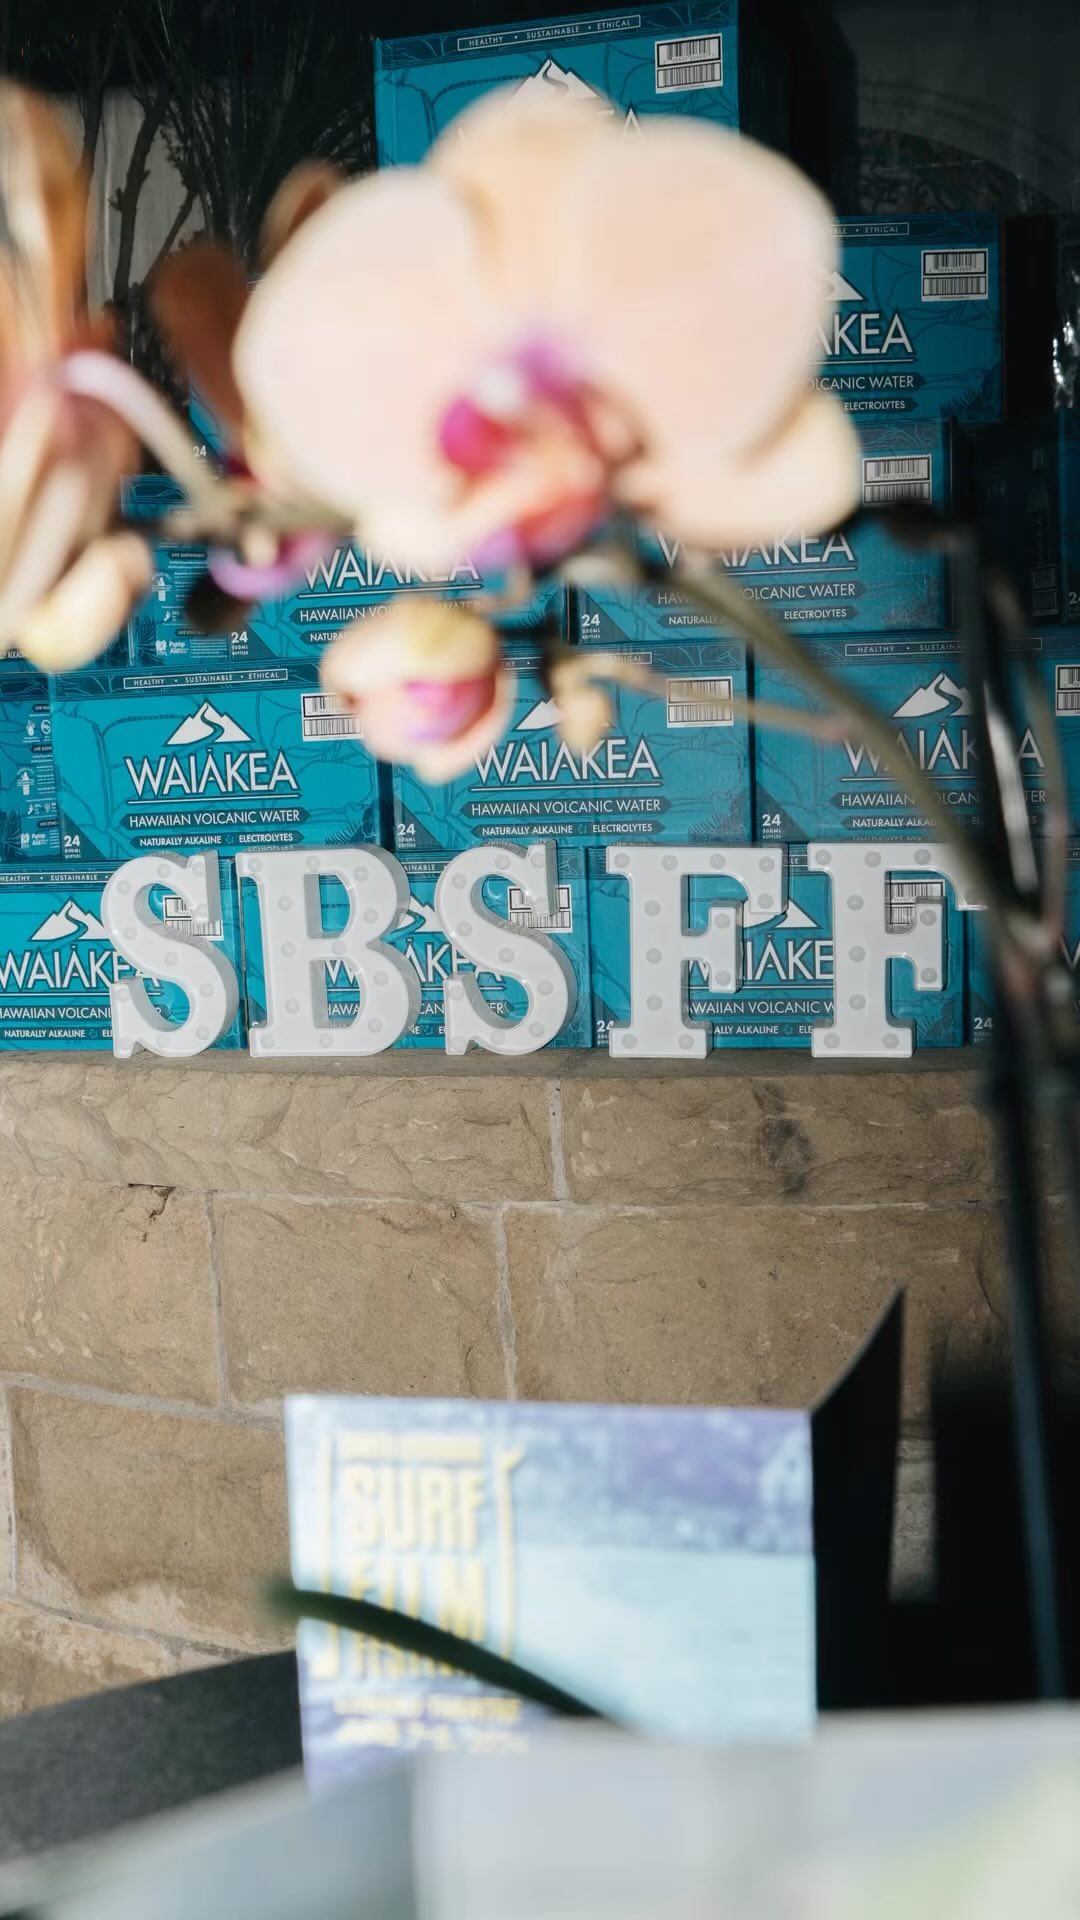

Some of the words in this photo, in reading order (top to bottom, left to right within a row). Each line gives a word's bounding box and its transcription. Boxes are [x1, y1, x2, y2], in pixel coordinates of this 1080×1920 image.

[469, 35, 504, 47] HEALTHY
[526, 25, 580, 40] SUSTAINABLE
[597, 19, 631, 31] ETHICAL
[869, 375, 914, 389] WATER
[844, 400, 905, 411] ELECTROLYTES
[193, 445, 207, 457] 24
[809, 584, 856, 598] WATER
[300, 608, 365, 622] HAWAIIAN
[582, 614, 600, 627] 24
[784, 608, 847, 620] ELECTROLYTES
[231, 631, 248, 643] 24
[857, 645, 894, 653] HEALTHY
[134, 678, 164, 686] HEALTHY
[185, 674, 233, 684] SUSTAINABLE
[248, 671, 279, 680] ETHICAL
[841, 793, 914, 806] HAWAIIAN
[471, 803, 540, 816] HAWAIIAN
[544, 801, 613, 814] VOLCANIC
[616, 799, 661, 812] WATER
[129, 814, 191, 828] HAWAIIAN
[194, 812, 256, 825] VOLCANIC
[260, 809, 300, 823] WATER
[762, 814, 782, 827] 24
[852, 818, 903, 828] NATURALLY
[397, 823, 415, 836] 24
[482, 826, 530, 836] NATURALLY
[532, 824, 573, 835] ALKALINE
[592, 823, 652, 833] ELECTROLYTES
[64, 835, 80, 847] 24
[139, 836, 183, 846] NATURALLY
[185, 834, 222, 845] ALKALINE
[239, 832, 293, 843] ELECTROLYTES
[50, 873, 98, 881] SUSTAINABLE
[58, 1008, 111, 1019] VOLCANI
[749, 1001, 820, 1014] VOLCANIC
[736, 1025, 778, 1034] ALKALINE
[973, 1017, 993, 1030] 24
[4, 1029, 47, 1038] NATURALLY
[48, 1029, 86, 1038] ALKALINE
